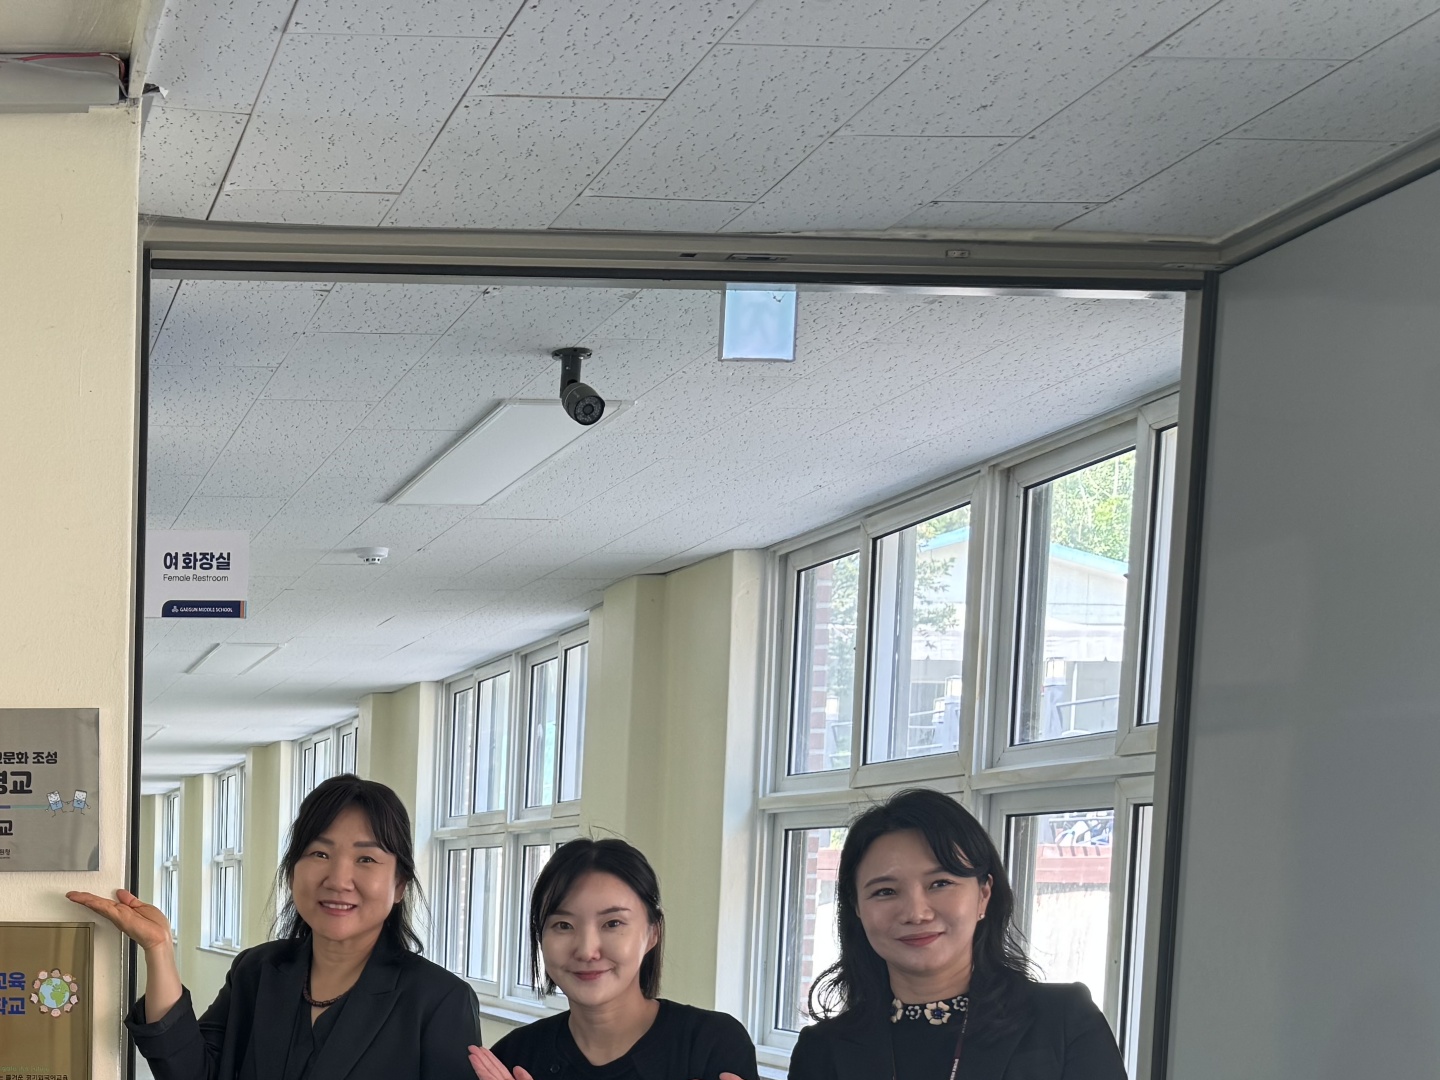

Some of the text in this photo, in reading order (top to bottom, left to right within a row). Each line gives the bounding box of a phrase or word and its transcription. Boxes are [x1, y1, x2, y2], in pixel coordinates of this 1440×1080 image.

[163, 552, 230, 570] 여 화장실
[163, 574, 228, 582] Female Restroom
[32, 752, 58, 765] 조성
